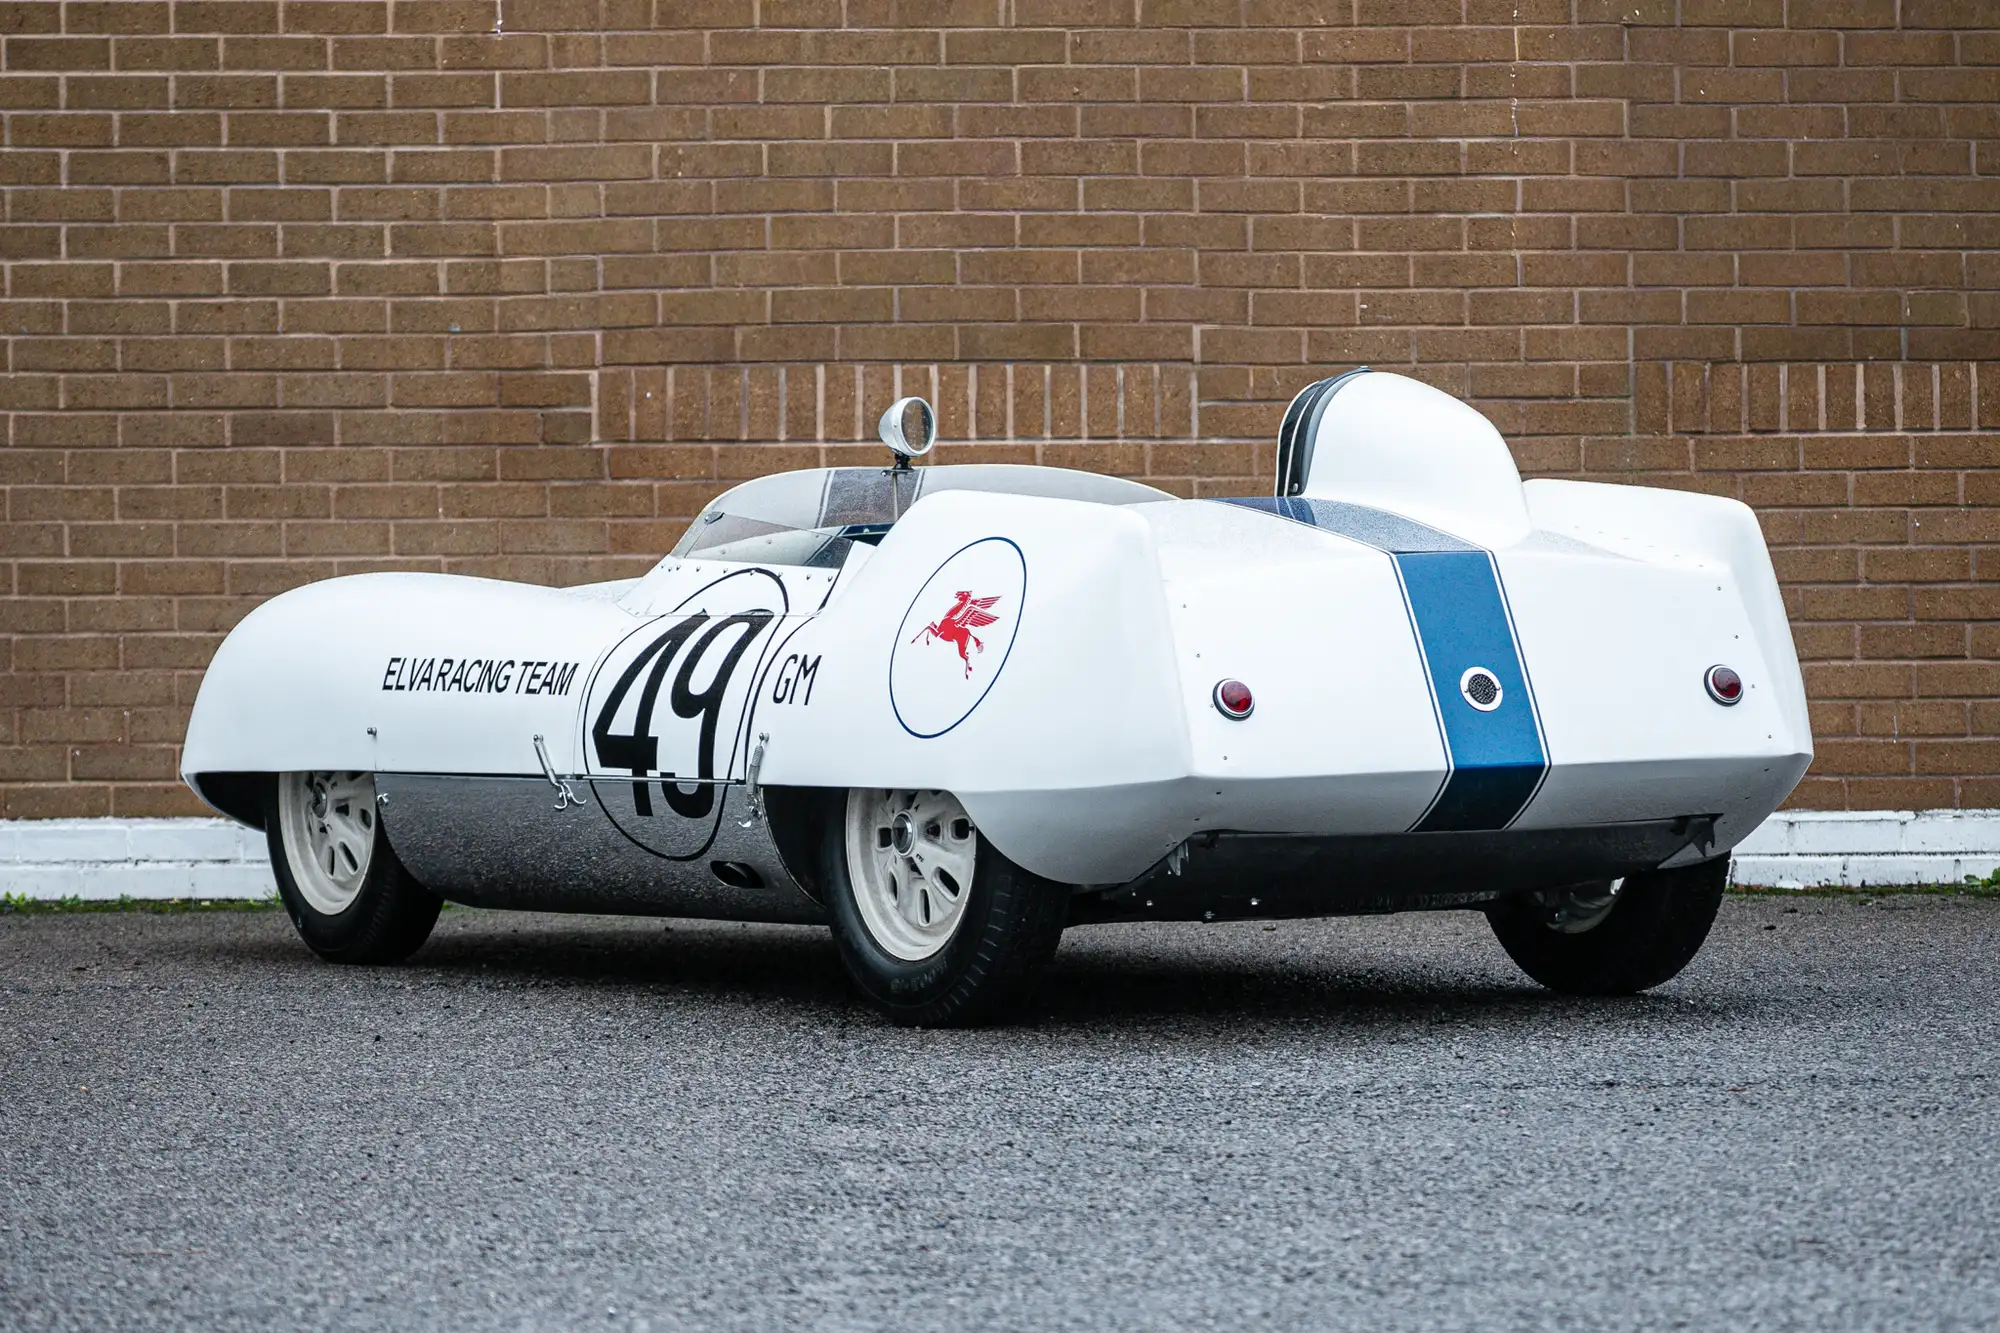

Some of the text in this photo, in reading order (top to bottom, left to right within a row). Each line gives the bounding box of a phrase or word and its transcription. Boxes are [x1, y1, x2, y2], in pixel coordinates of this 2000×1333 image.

[382, 657, 580, 696] ELVA RACING TEAM
[773, 654, 822, 706] GM
[592, 608, 775, 819] 49
